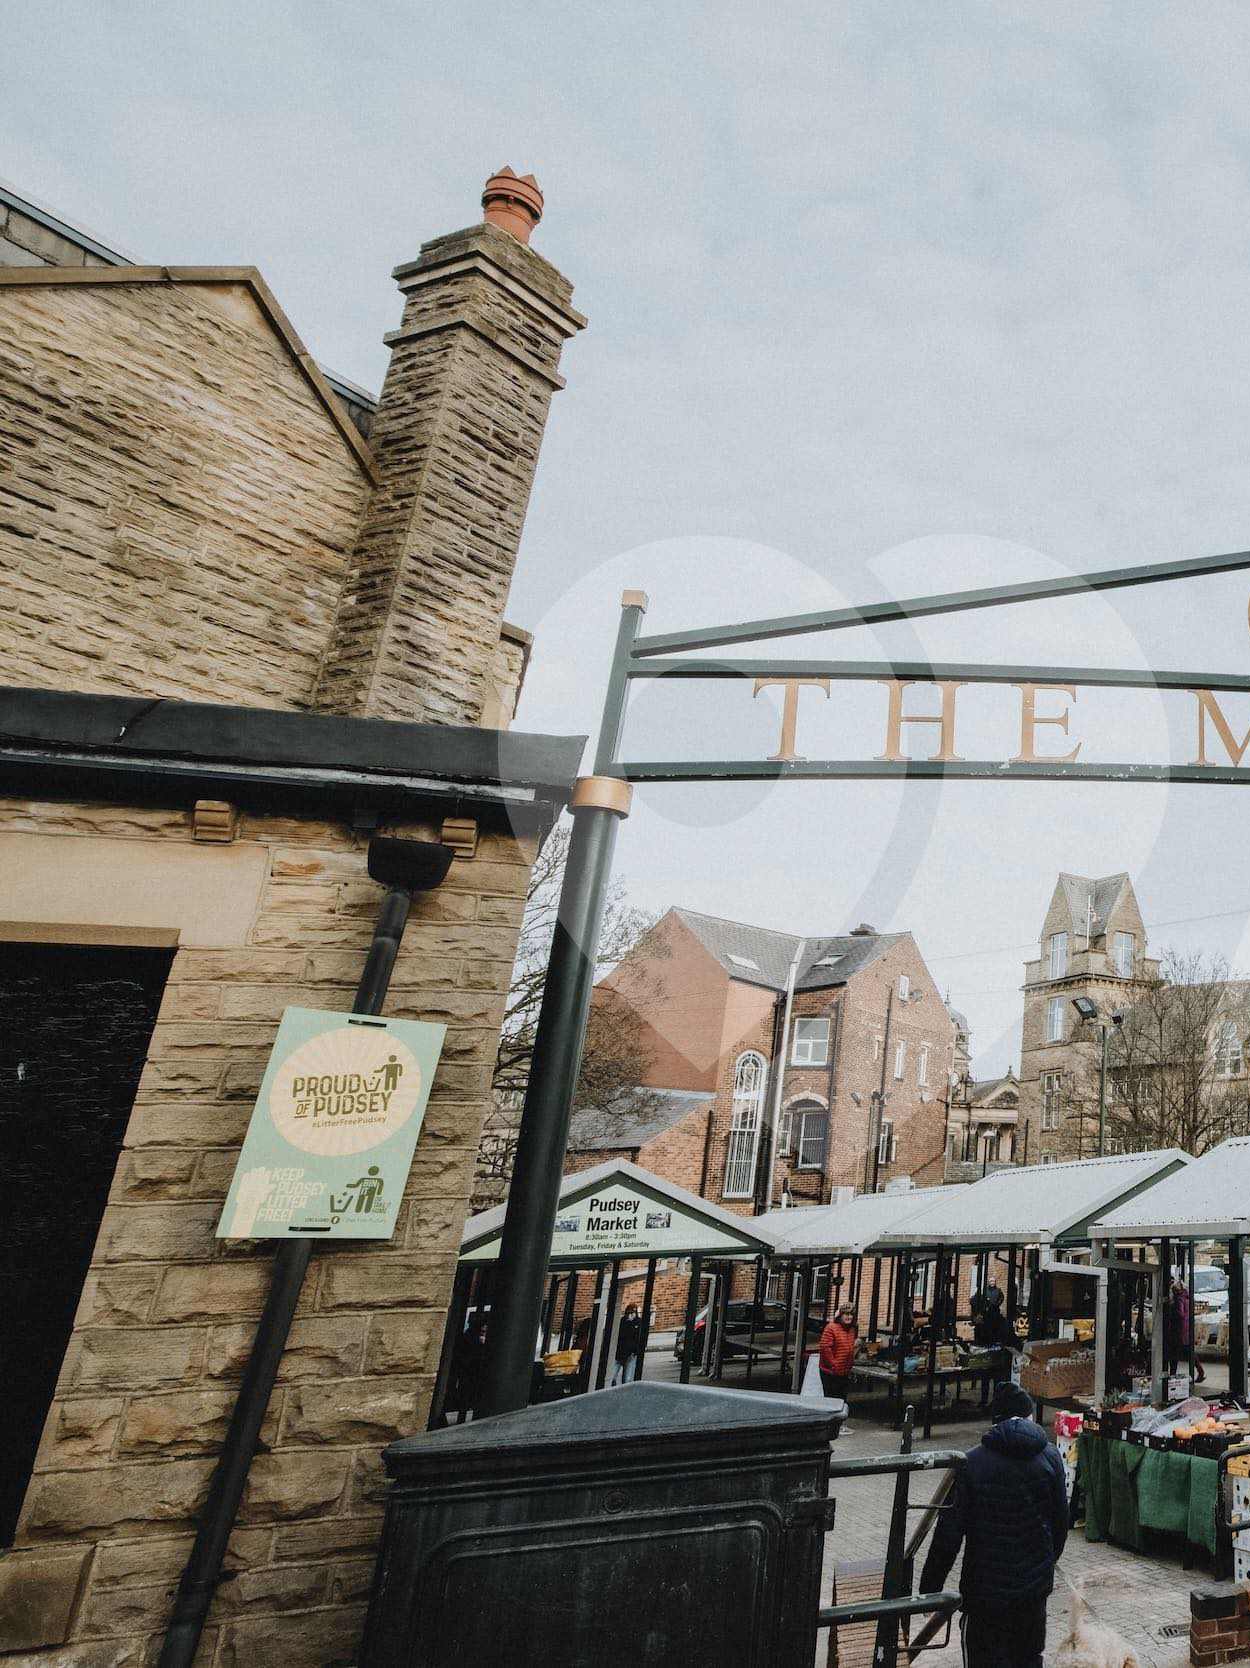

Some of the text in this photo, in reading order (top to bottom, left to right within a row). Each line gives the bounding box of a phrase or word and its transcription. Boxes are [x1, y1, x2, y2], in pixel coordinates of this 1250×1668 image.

[752, 677, 1083, 763] THE
[292, 1074, 361, 1098] PROUD
[295, 1092, 392, 1117] OF PUDSEY
[272, 1168, 304, 1181] KEEP
[277, 1181, 327, 1195] PUDSEY
[589, 1198, 640, 1214] Pudsey
[586, 1217, 638, 1231] Market
[623, 1240, 649, 1249] Saturday
